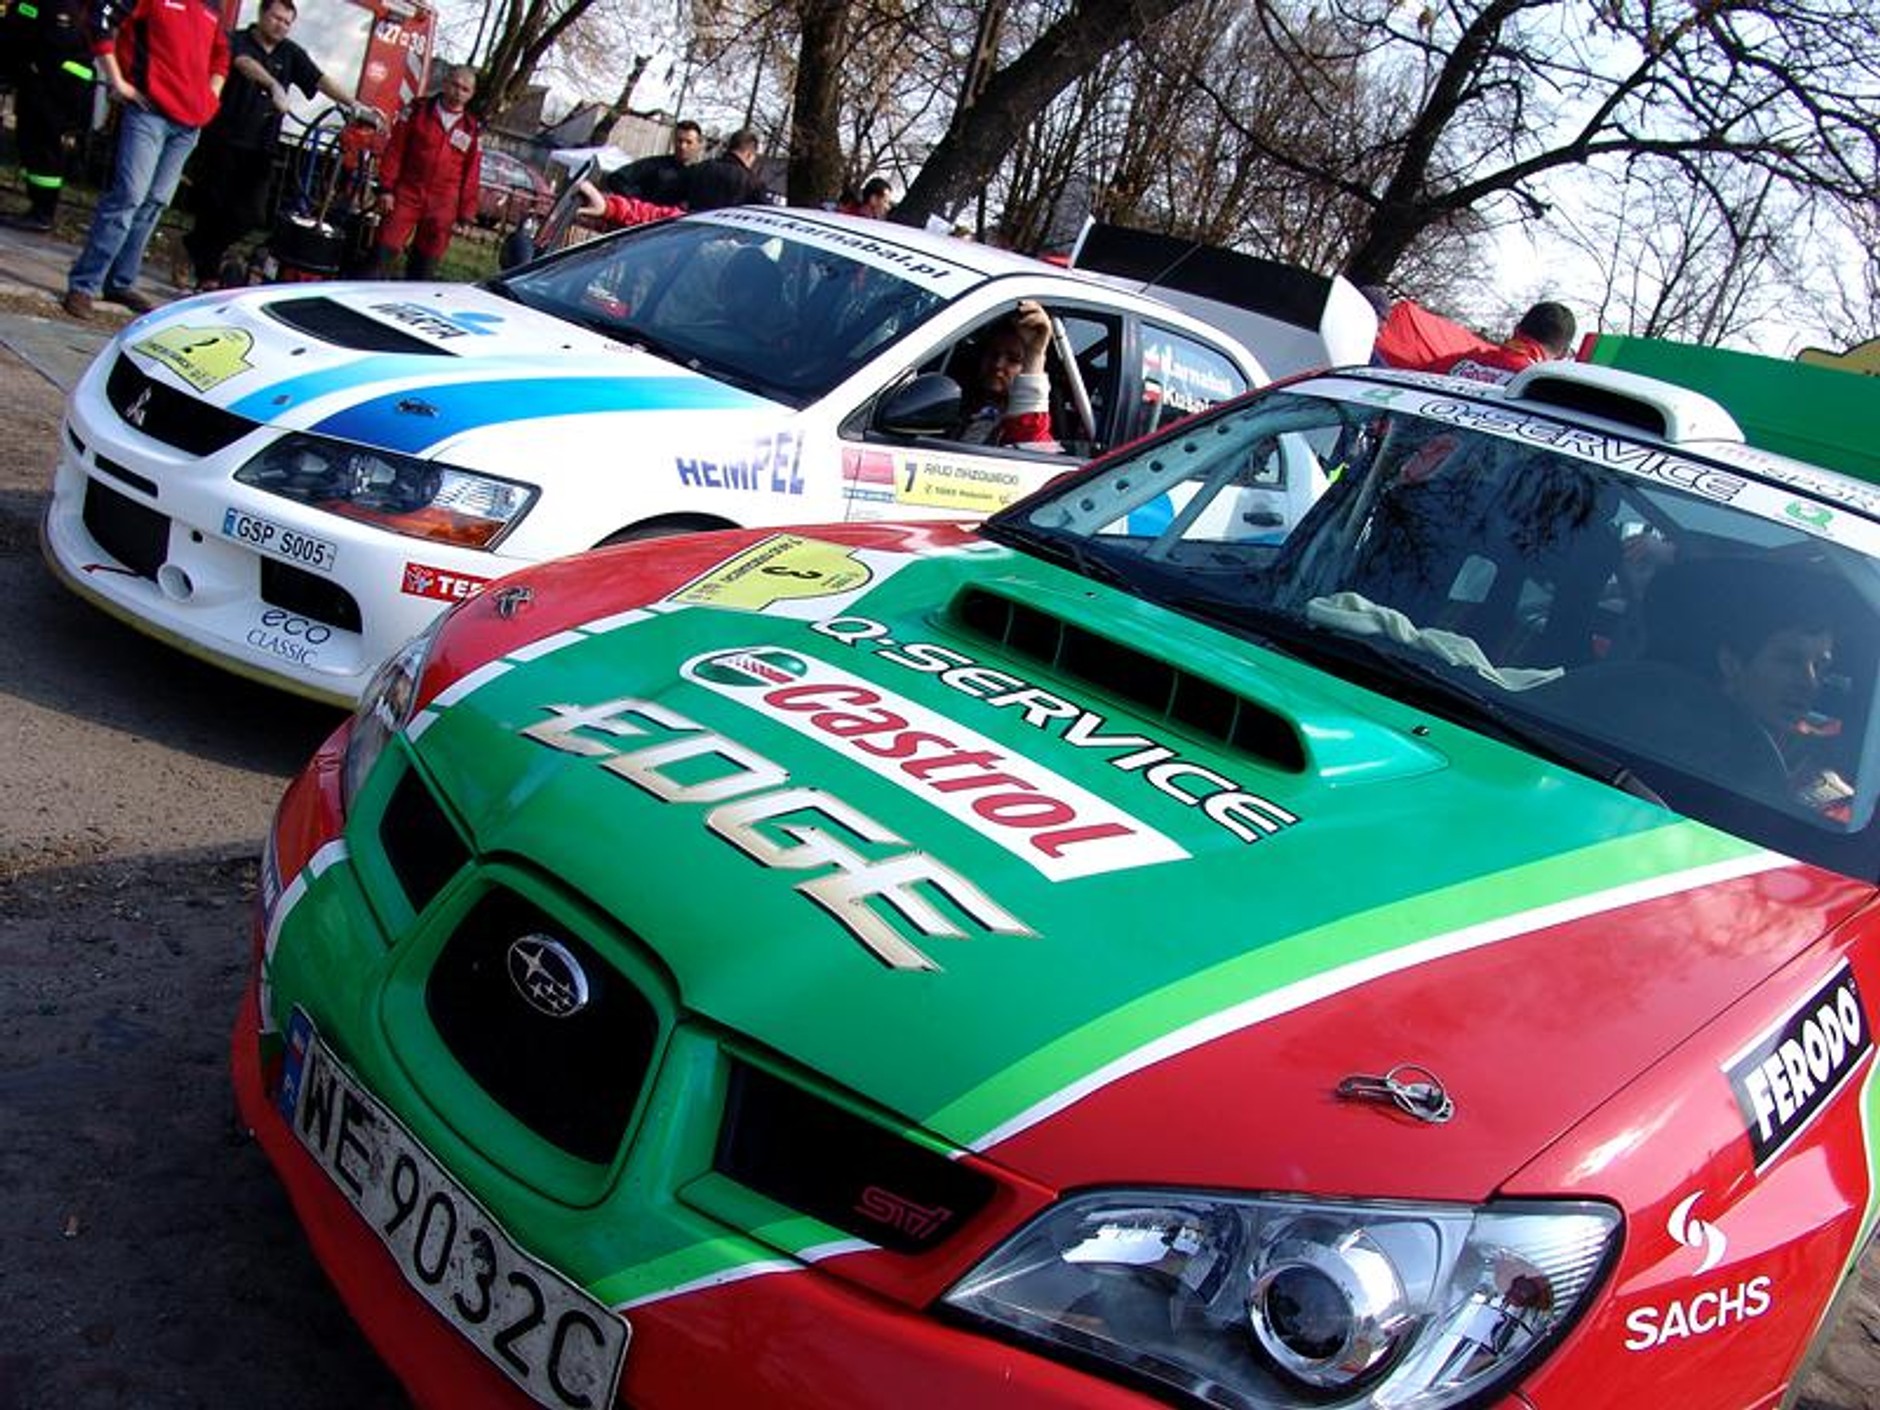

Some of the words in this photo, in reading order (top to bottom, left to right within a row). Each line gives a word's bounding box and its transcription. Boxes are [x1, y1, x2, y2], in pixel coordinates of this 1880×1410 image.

[675, 430, 804, 494] HEMPEL
[904, 463, 918, 492] 7
[238, 516, 275, 544] GSP
[280, 531, 326, 564] S005
[246, 629, 319, 668] CLASSIC
[262, 608, 330, 645] eco
[808, 615, 1302, 845] Q-SERVICE
[763, 682, 1140, 860] Castrol
[520, 697, 1043, 974] EDGE
[1744, 985, 1861, 1143] FERODO
[301, 1048, 378, 1200] WE
[384, 1146, 606, 1410] 9032C
[1624, 1276, 1772, 1352] SACHS
